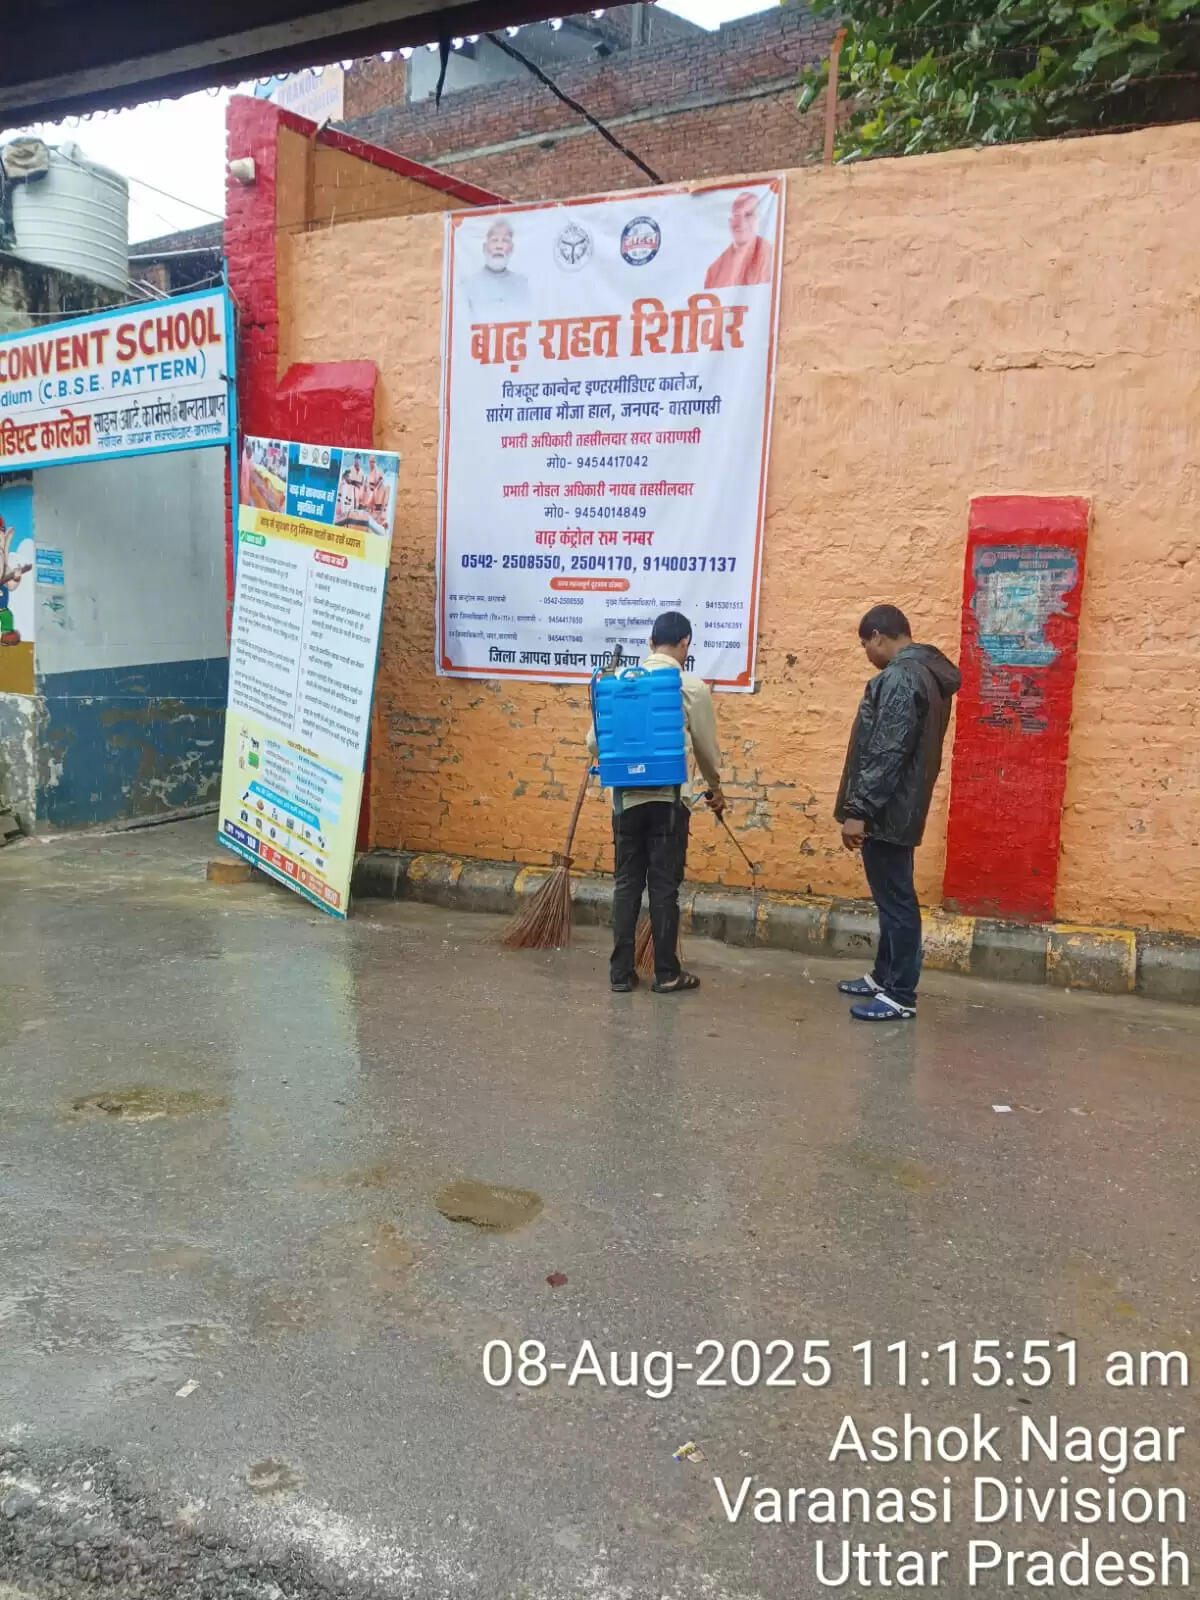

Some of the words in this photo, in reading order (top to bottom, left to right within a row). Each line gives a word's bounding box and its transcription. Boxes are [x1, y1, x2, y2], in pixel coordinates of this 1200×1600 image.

[116, 306, 222, 361] SCHOOL
[470, 320, 532, 373] बाढ़
[538, 314, 622, 360] राहत
[630, 293, 749, 357] शिविर
[0, 388, 32, 407] dium
[111, 350, 207, 389] PATTERN)
[502, 379, 539, 403] चित्रकूट
[542, 377, 582, 398] कान्वेन्ट
[585, 374, 656, 396] इण्टरमीडिएट
[659, 371, 703, 394] कालेज,
[485, 402, 513, 423] सारंग
[516, 404, 552, 422] तालाब
[556, 400, 584, 421] मौजा
[588, 401, 616, 421] हाल,
[621, 400, 664, 418] जनपद-
[668, 394, 722, 416] वाराणसी
[0, 418, 38, 457] डिएट
[40, 408, 92, 450] कालेज
[501, 432, 528, 449] प्रभारी
[531, 430, 573, 448] अधिकारी
[576, 428, 627, 448] तहसीलदार
[630, 429, 652, 446] सदर
[655, 426, 701, 445] वाराणसी
[577, 455, 649, 469] 9454417042
[502, 481, 529, 498] प्रभारी
[532, 481, 560, 498] नोडल
[563, 480, 605, 498] अधिकारी
[609, 482, 637, 498] नायब
[640, 479, 696, 497] तहसीलदार
[574, 506, 647, 519] 9454014849
[534, 529, 557, 550] बाढ़
[622, 530, 655, 547] नम्बर
[461, 553, 498, 569] 0542-
[502, 554, 566, 572] 2508550,
[571, 555, 638, 574] 2504170,
[642, 555, 737, 573] 9140037137
[488, 646, 516, 664] जिला
[519, 650, 551, 666] आपदा
[554, 649, 587, 667] प्रबंधन
